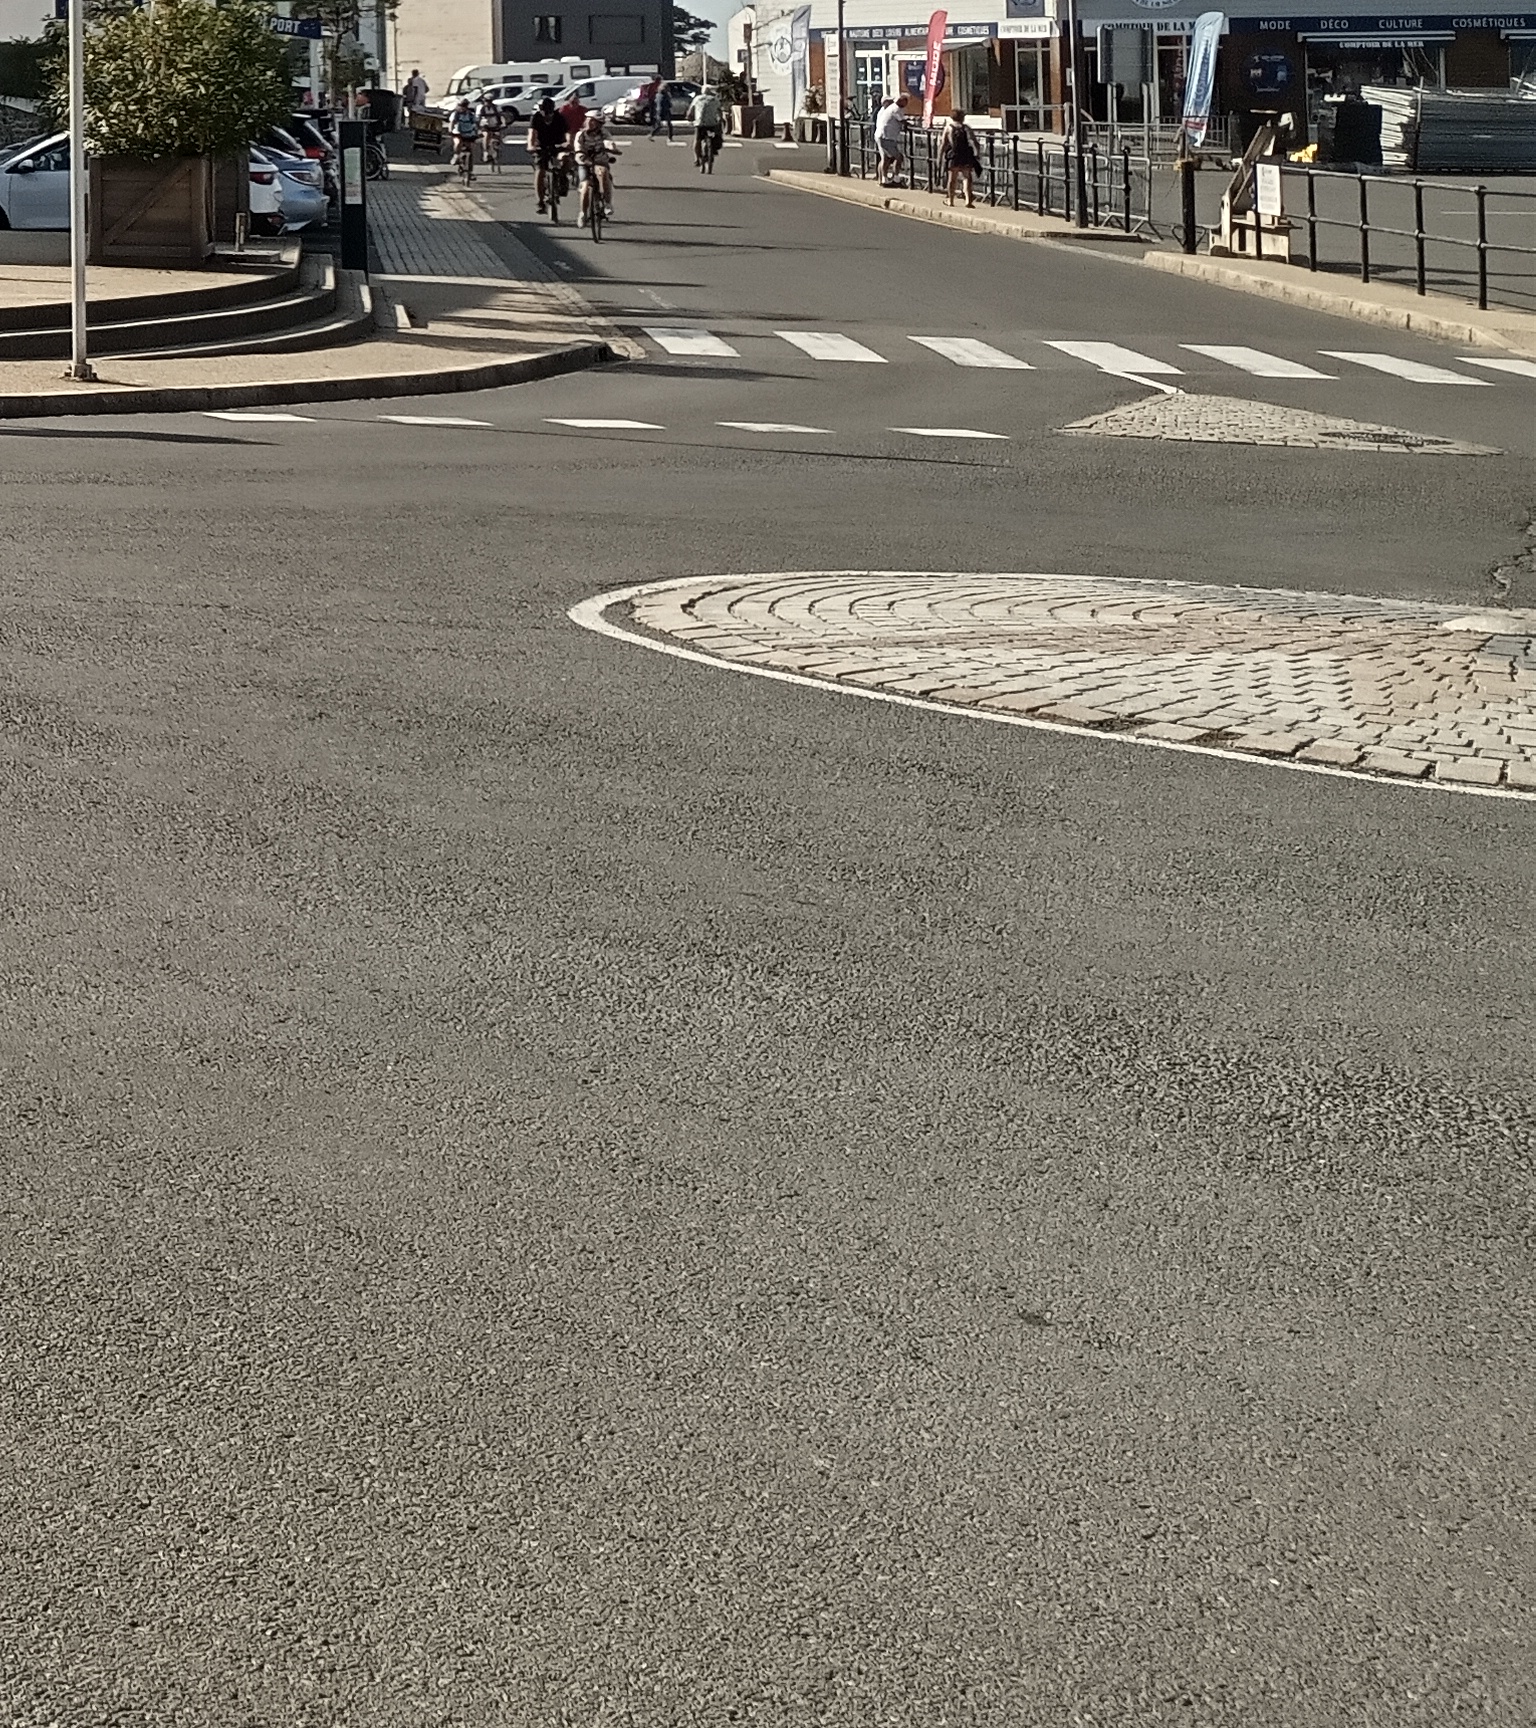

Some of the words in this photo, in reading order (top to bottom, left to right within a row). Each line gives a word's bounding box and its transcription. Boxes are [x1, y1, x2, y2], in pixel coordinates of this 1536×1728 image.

[269, 17, 301, 34] PORT
[1157, 22, 1170, 31] DE
[1173, 21, 1185, 31] LA
[1260, 20, 1291, 30] MODE
[1320, 18, 1349, 30] DÉCO
[1378, 18, 1423, 29] CULTURE
[1452, 16, 1526, 28] COSMÉTIQUES
